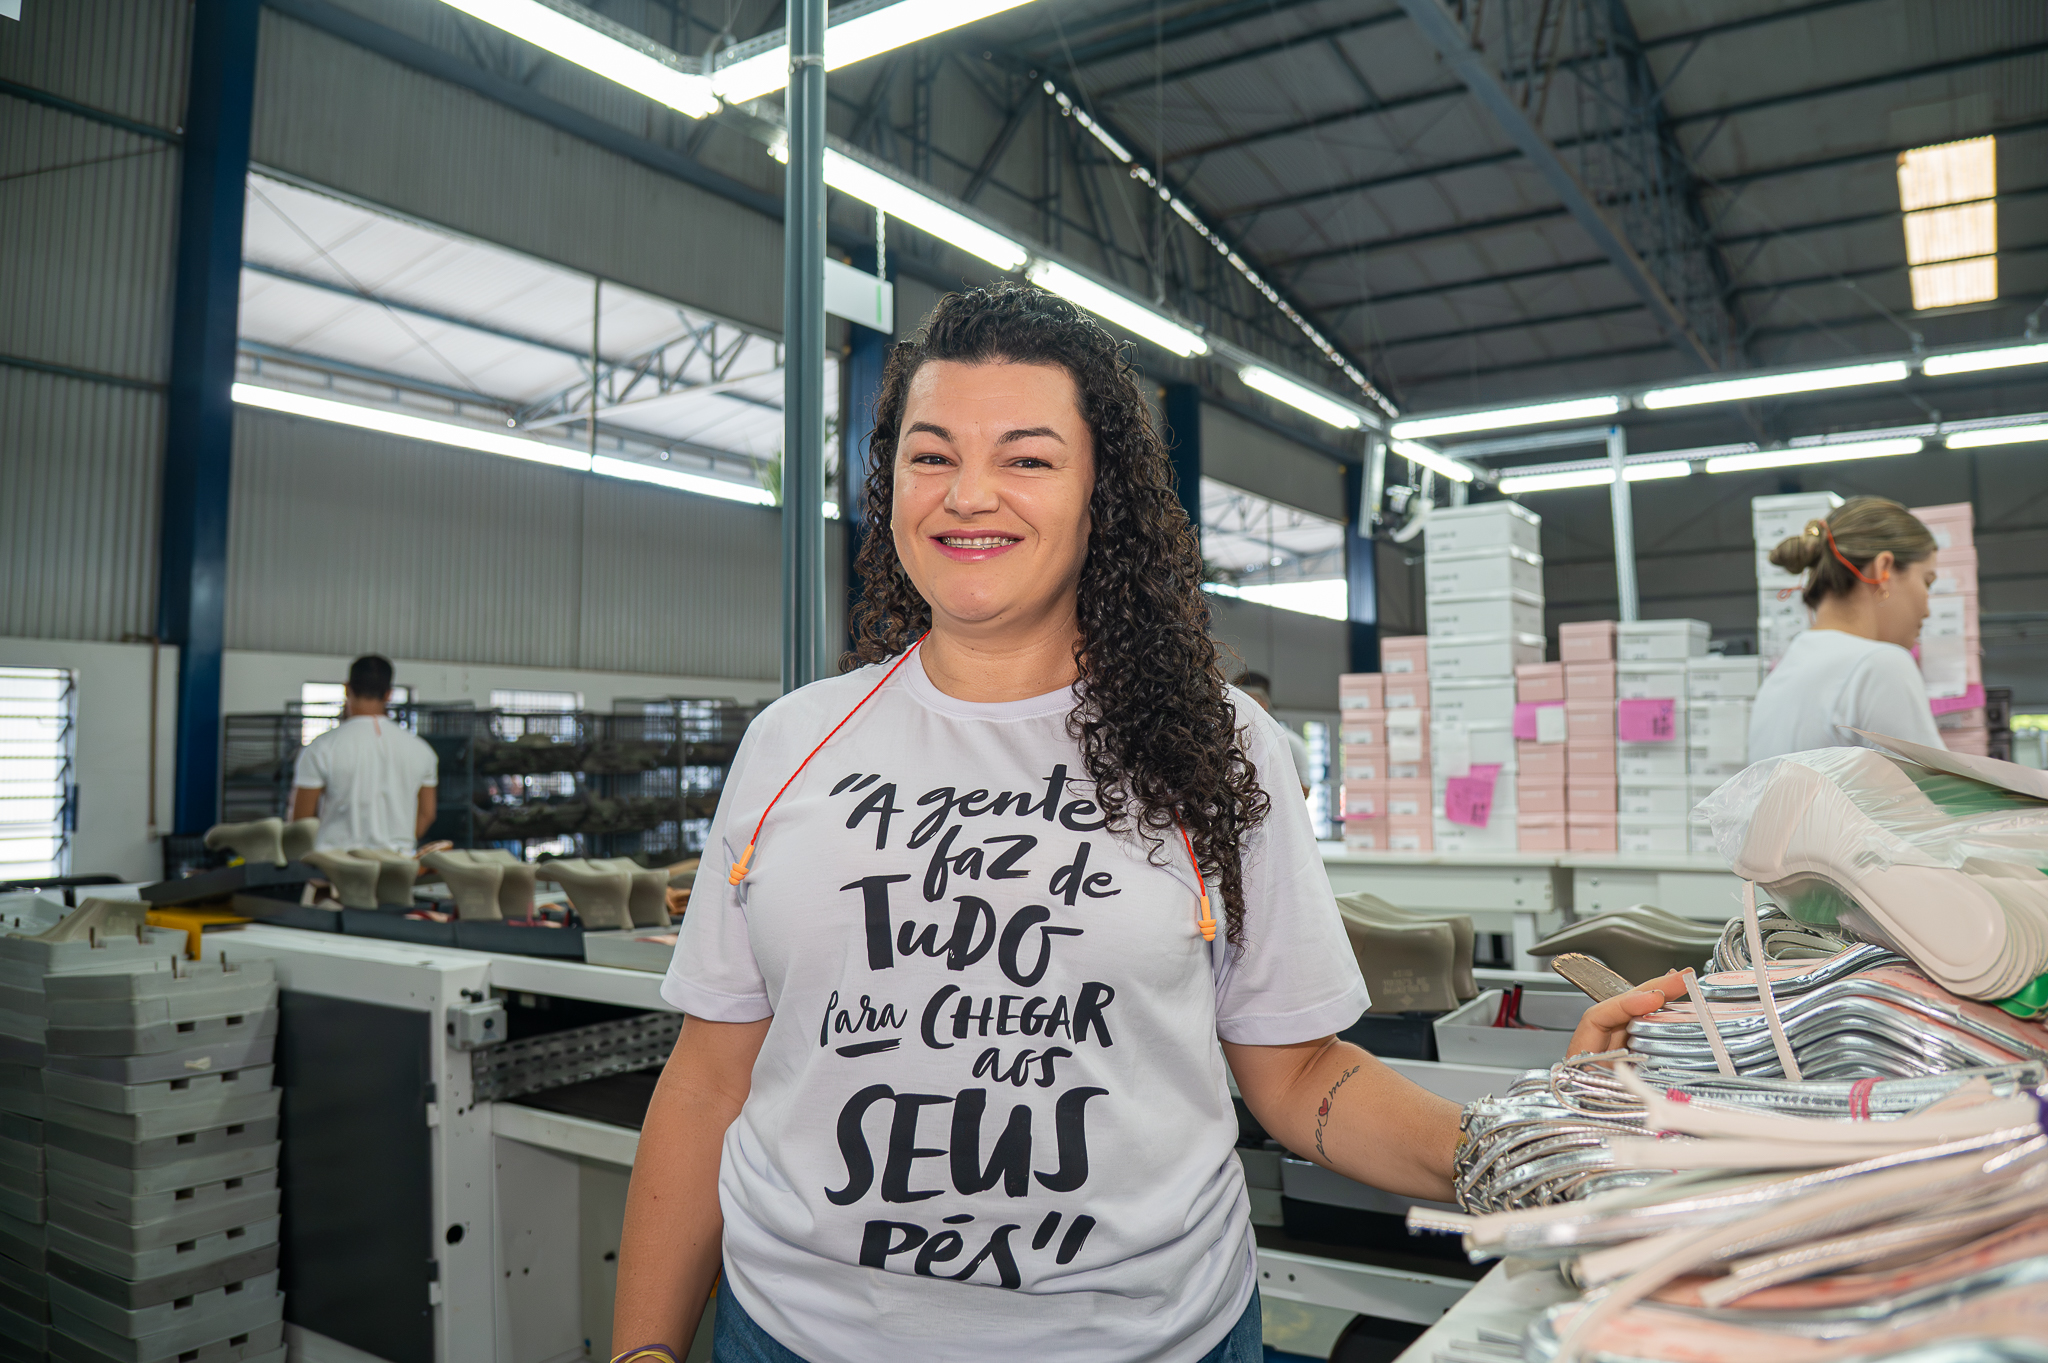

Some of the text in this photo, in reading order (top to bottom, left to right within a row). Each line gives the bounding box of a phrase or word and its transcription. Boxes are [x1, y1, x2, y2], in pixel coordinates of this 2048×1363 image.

[907, 764, 1106, 850] gente
[923, 824, 1121, 906] faz de
[921, 982, 1115, 1049] CHEGAR
[972, 1047, 1072, 1087] aos
[824, 1084, 1109, 1205] SEUS
[1315, 1112, 1333, 1164] pai
